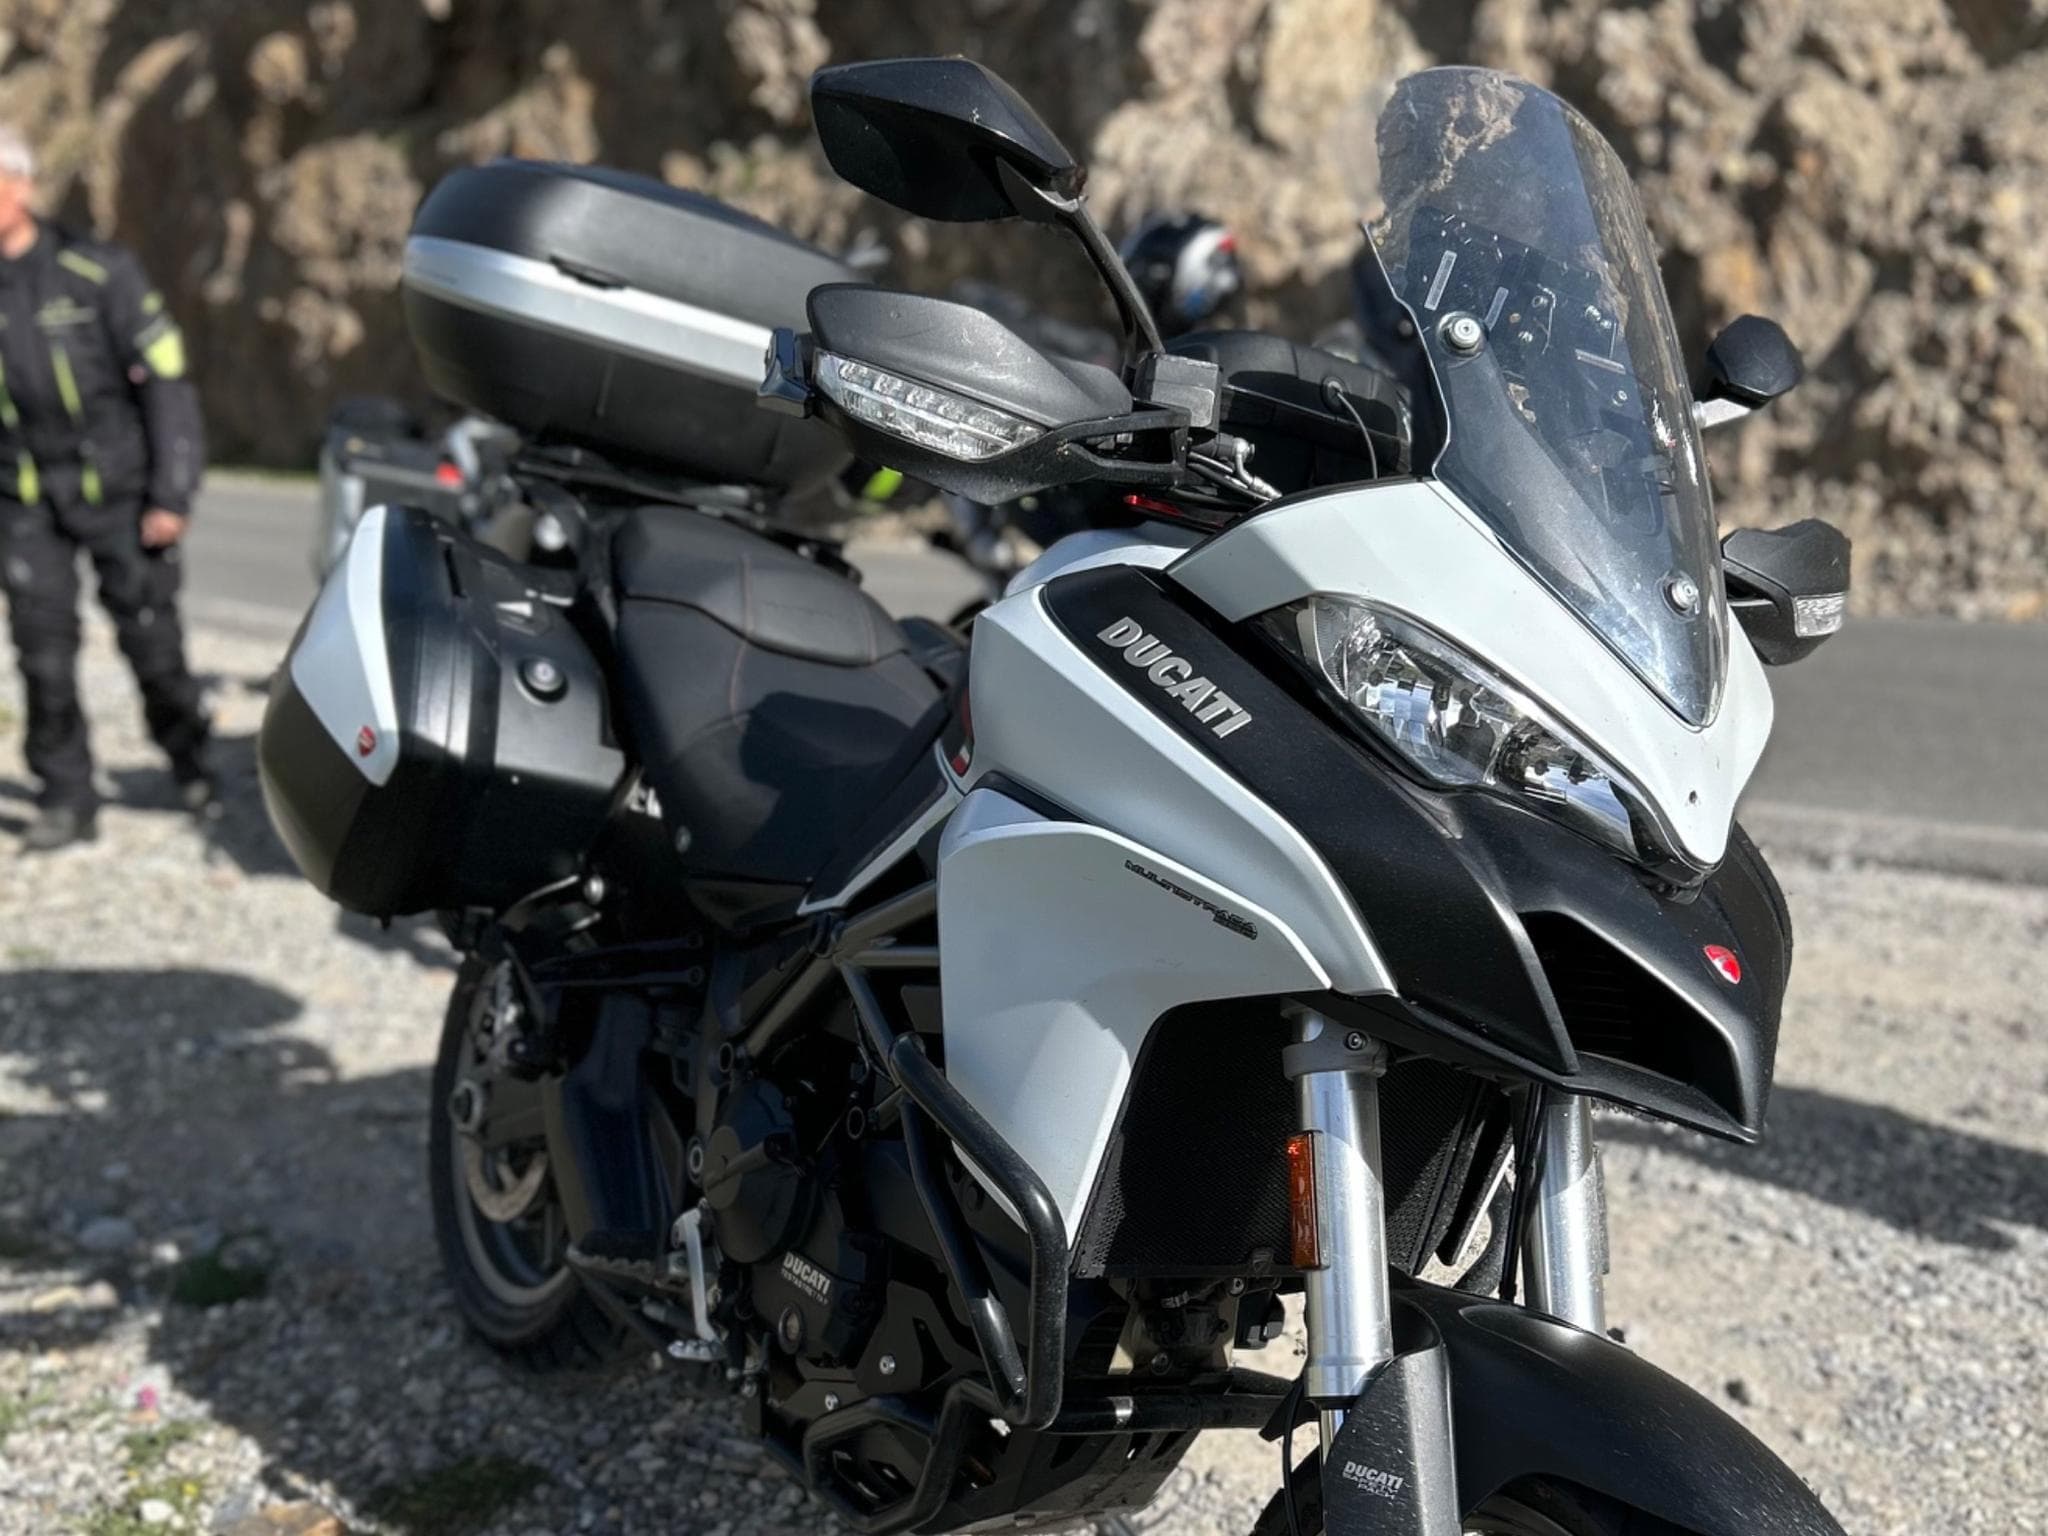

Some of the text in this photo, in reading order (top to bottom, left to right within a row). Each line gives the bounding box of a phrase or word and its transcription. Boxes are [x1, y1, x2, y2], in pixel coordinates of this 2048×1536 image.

[1096, 616, 1252, 739] DUCATI
[783, 1251, 831, 1295] DUCATI
[1344, 1461, 1404, 1490] DUCATI
